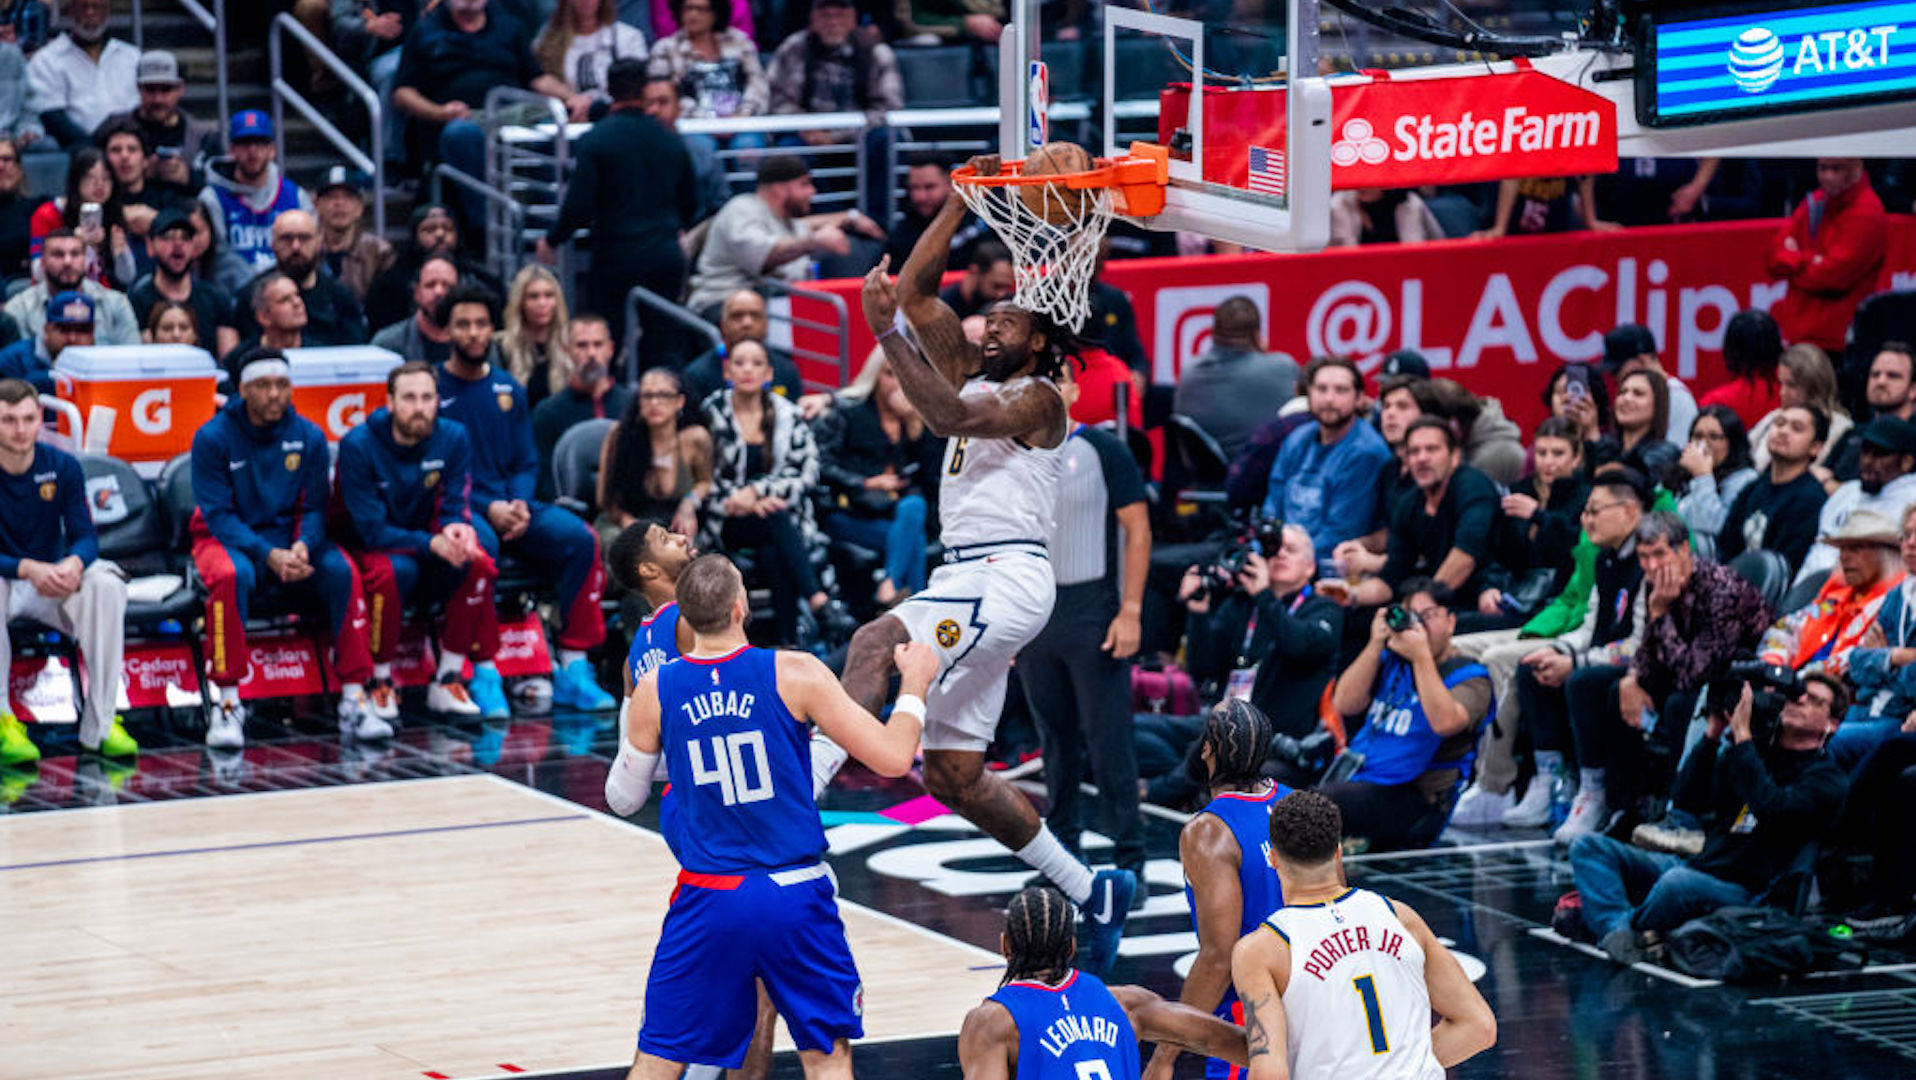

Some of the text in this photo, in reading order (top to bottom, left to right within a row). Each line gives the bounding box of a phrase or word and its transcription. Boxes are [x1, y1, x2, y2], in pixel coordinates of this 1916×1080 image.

[1793, 25, 1898, 75] AT&T
[131, 388, 172, 435] G
[327, 392, 366, 437] G
[127, 657, 187, 675] Cedars
[250, 647, 310, 666] Cedars
[682, 690, 755, 726] ZUBAC
[687, 730, 775, 807] 40
[1303, 926, 1404, 982] PORTER JR.
[1040, 1014, 1119, 1058] LEONARD
[1352, 973, 1391, 1056] 1
